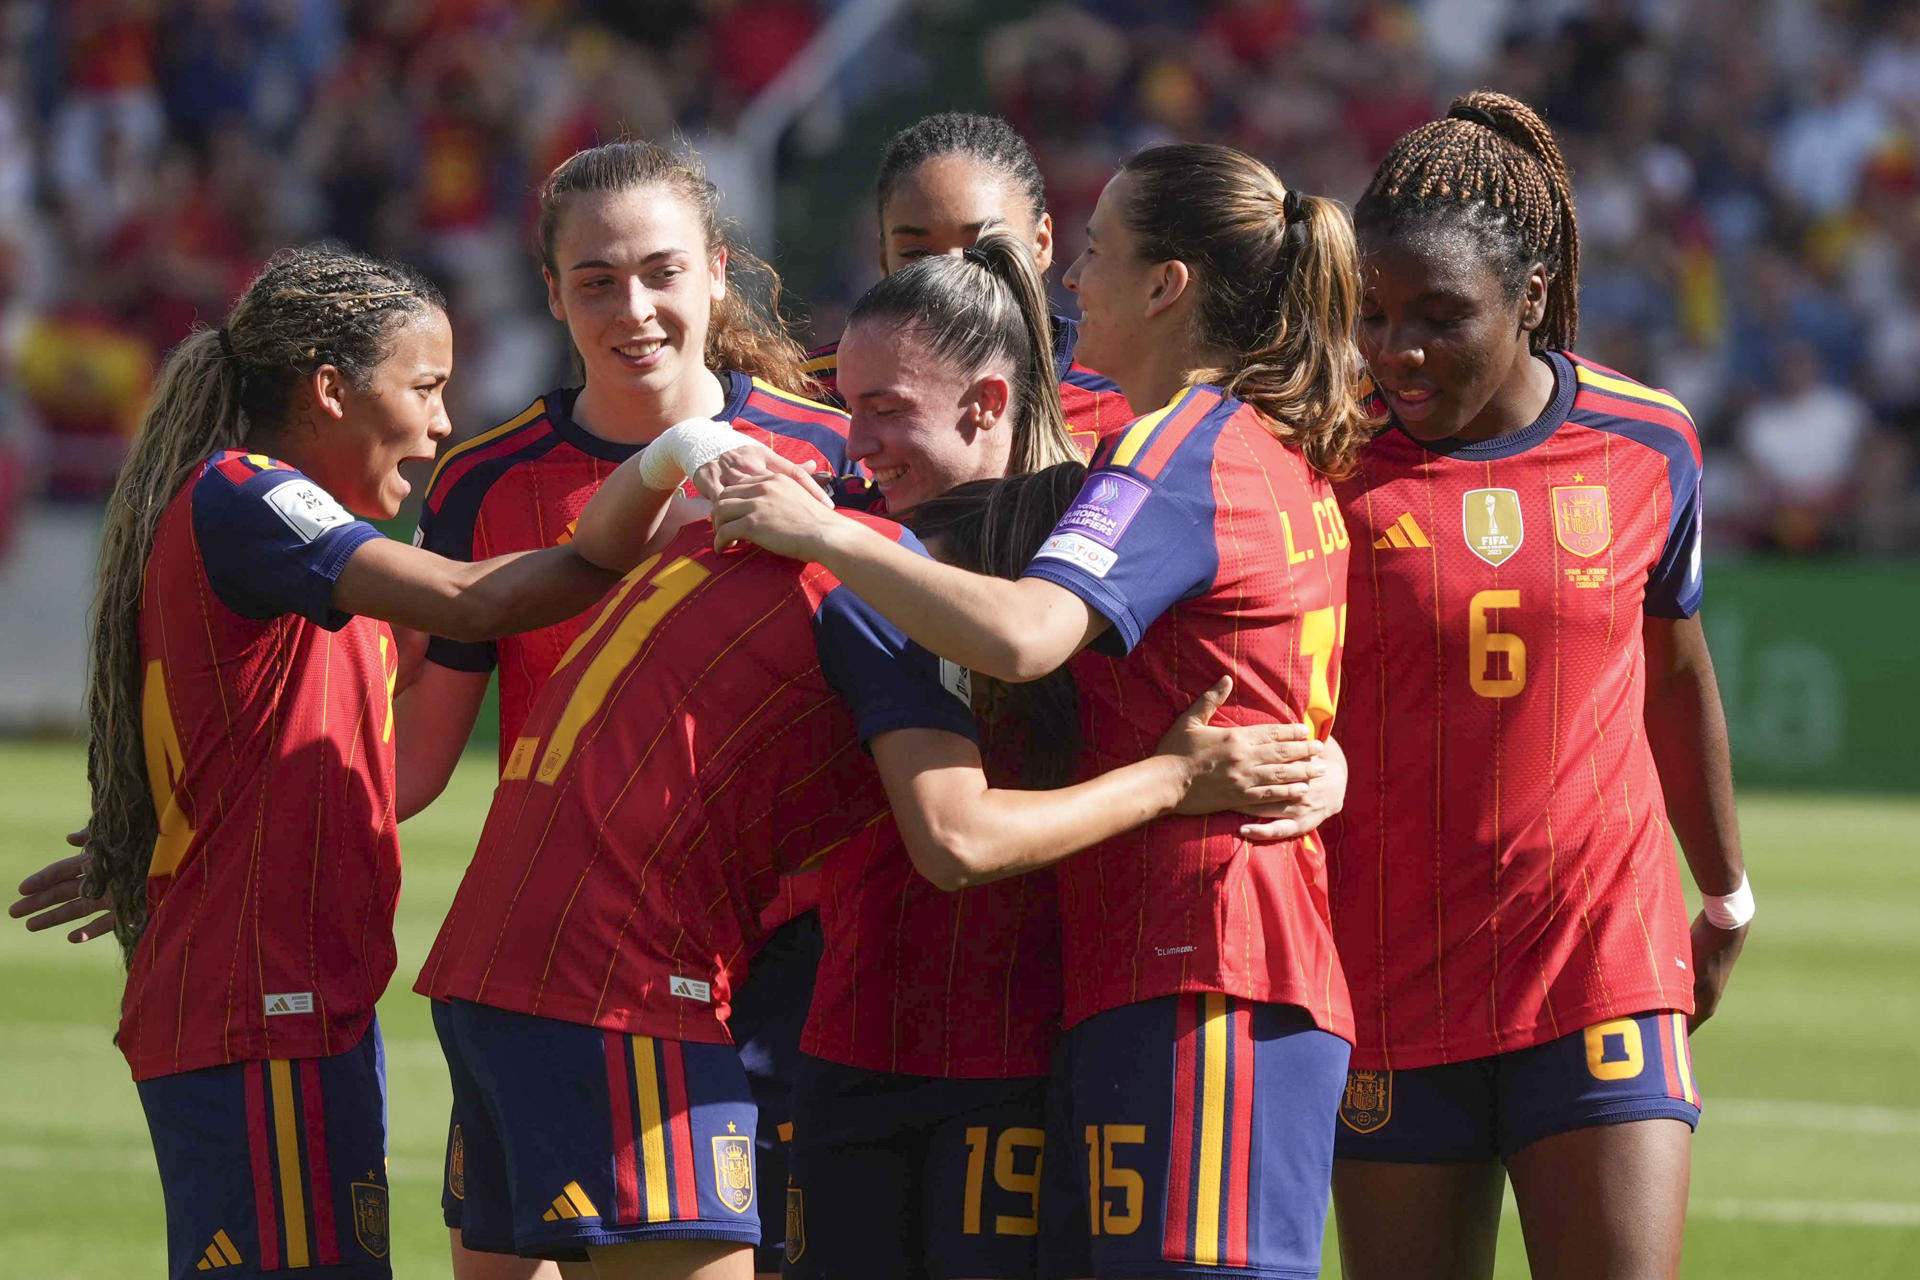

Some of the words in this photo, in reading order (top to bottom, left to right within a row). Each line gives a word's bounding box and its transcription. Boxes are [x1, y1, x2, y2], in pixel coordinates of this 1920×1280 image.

[1064, 509, 1118, 529] EUROPEAN
[1280, 510, 1315, 565] L.
[1481, 536, 1508, 546] FIFA
[1469, 589, 1527, 698] 6
[962, 1126, 1046, 1237] 19
[1085, 1124, 1147, 1236] 15
